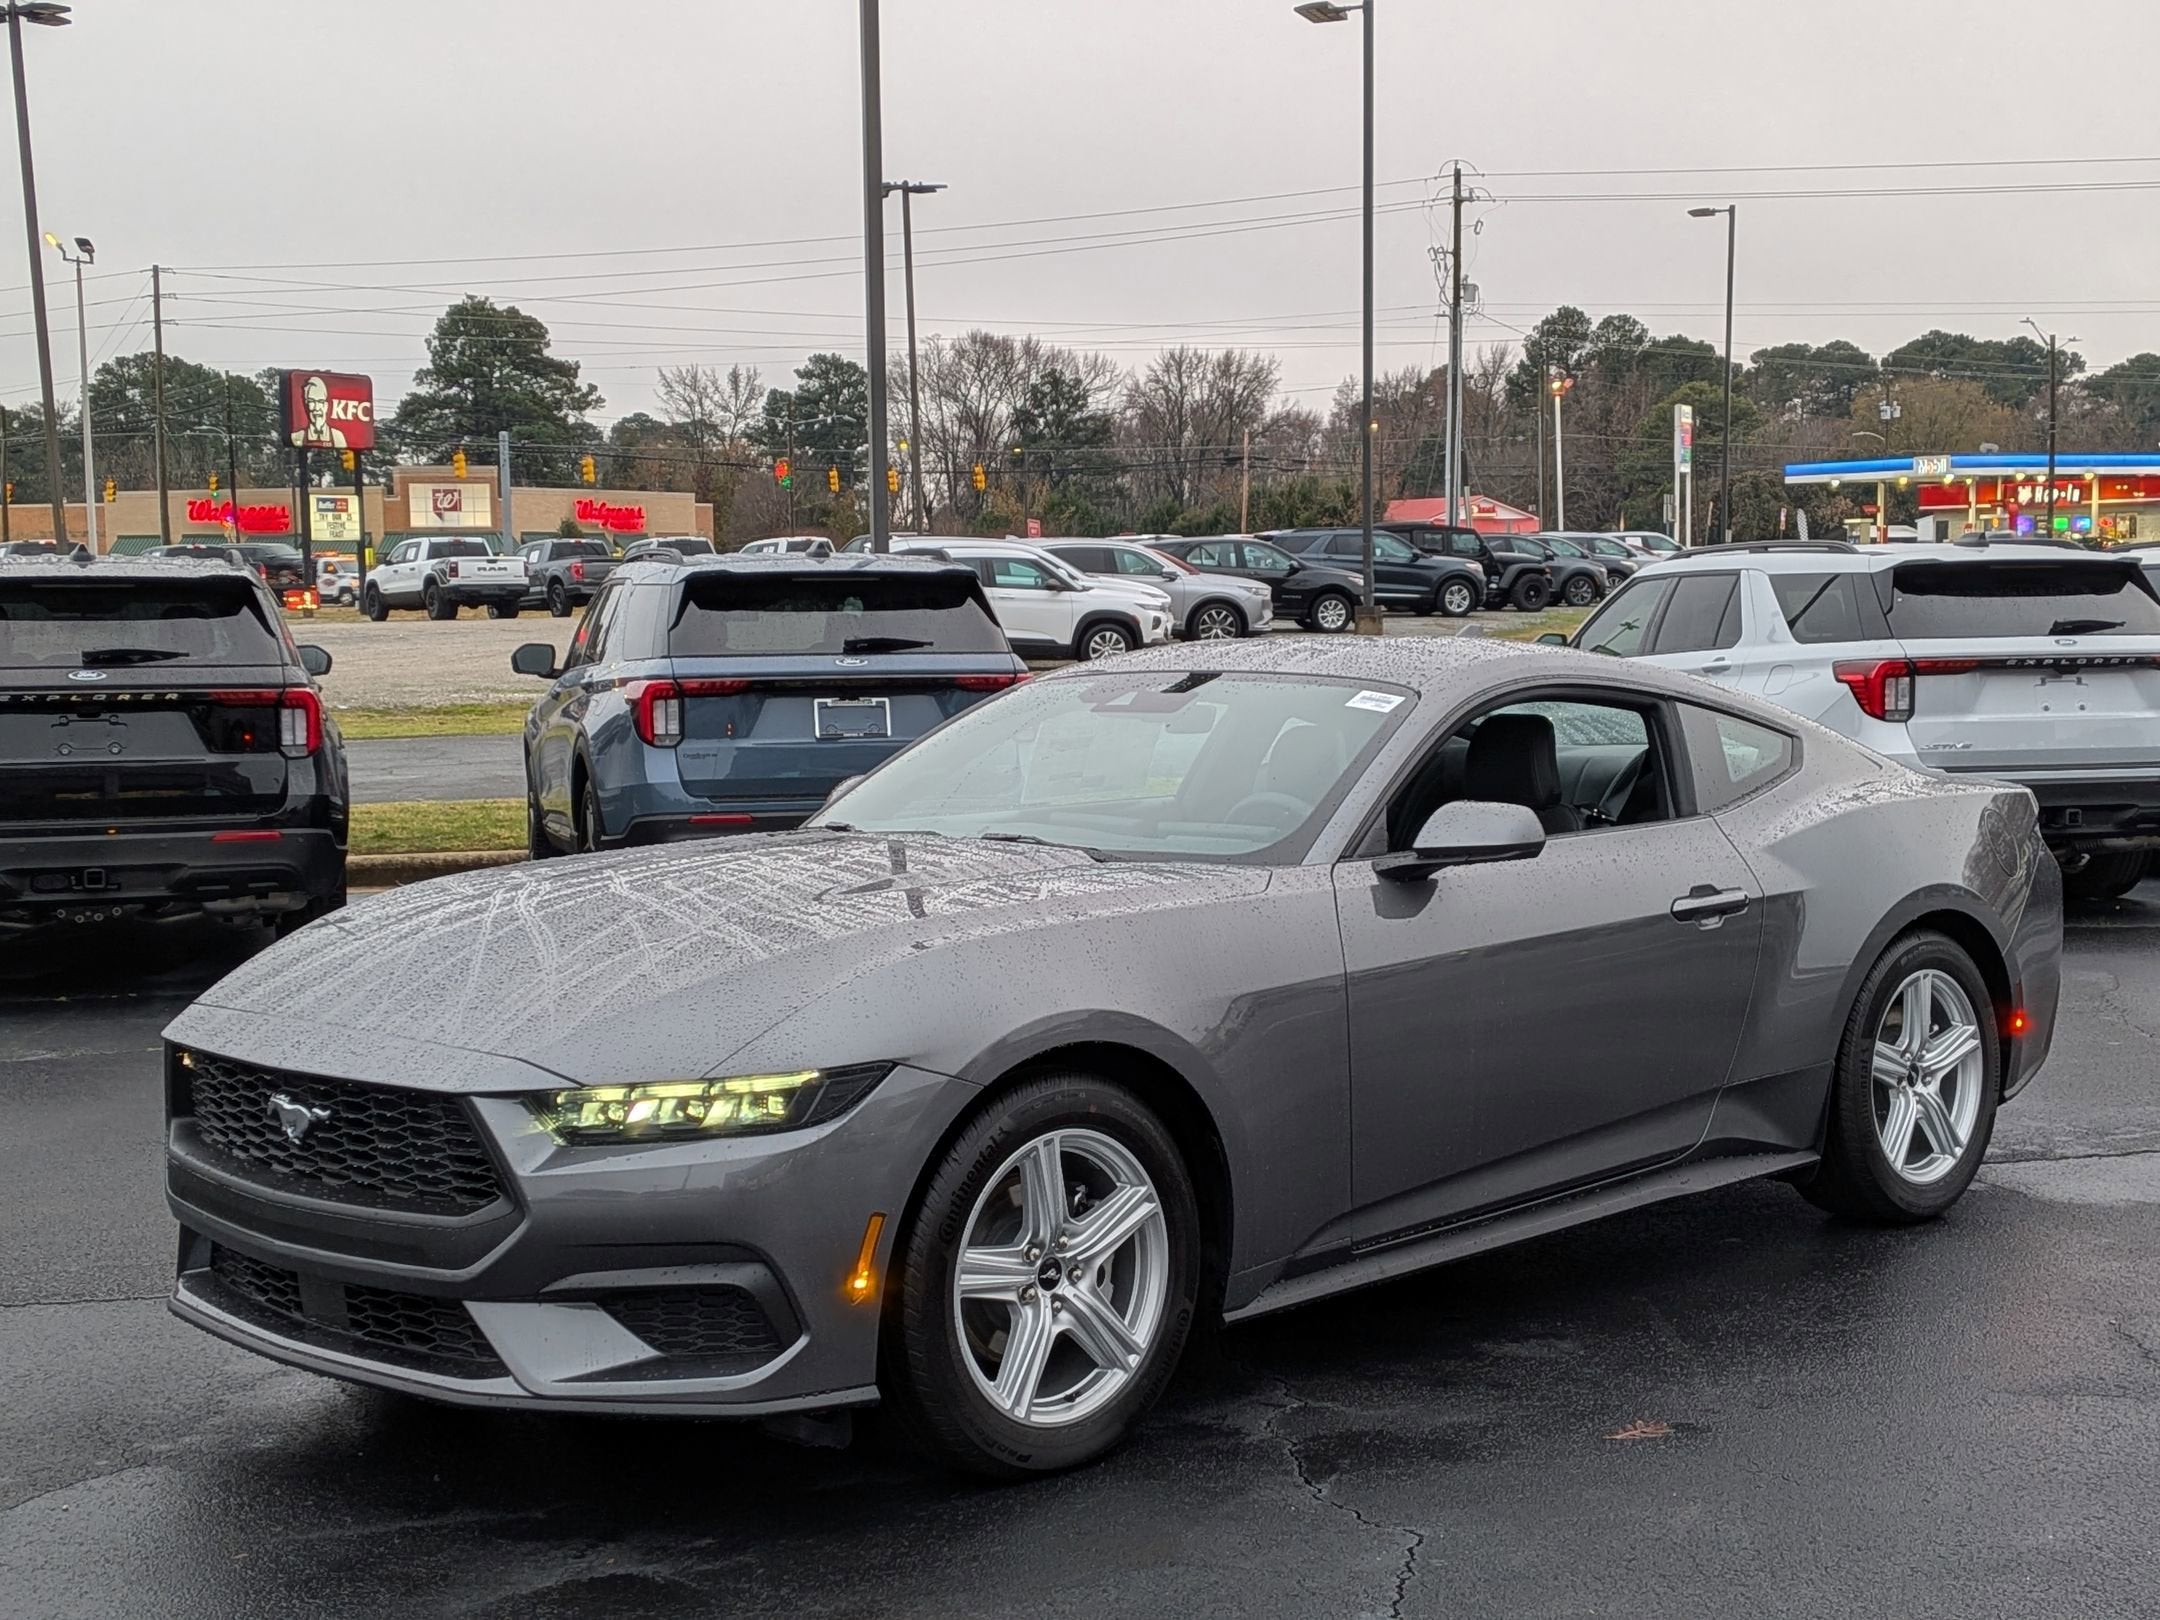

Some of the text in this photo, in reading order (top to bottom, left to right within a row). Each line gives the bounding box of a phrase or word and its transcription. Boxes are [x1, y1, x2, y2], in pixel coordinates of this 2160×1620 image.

[330, 399, 371, 422] KFC
[1918, 458, 1947, 474] Mobil
[187, 499, 289, 521] Walreens
[576, 499, 644, 527] Walgreens
[329, 530, 344, 538] FEAST
[2006, 657, 2136, 666] EXPLORER
[0, 692, 180, 702] EXPLORER
